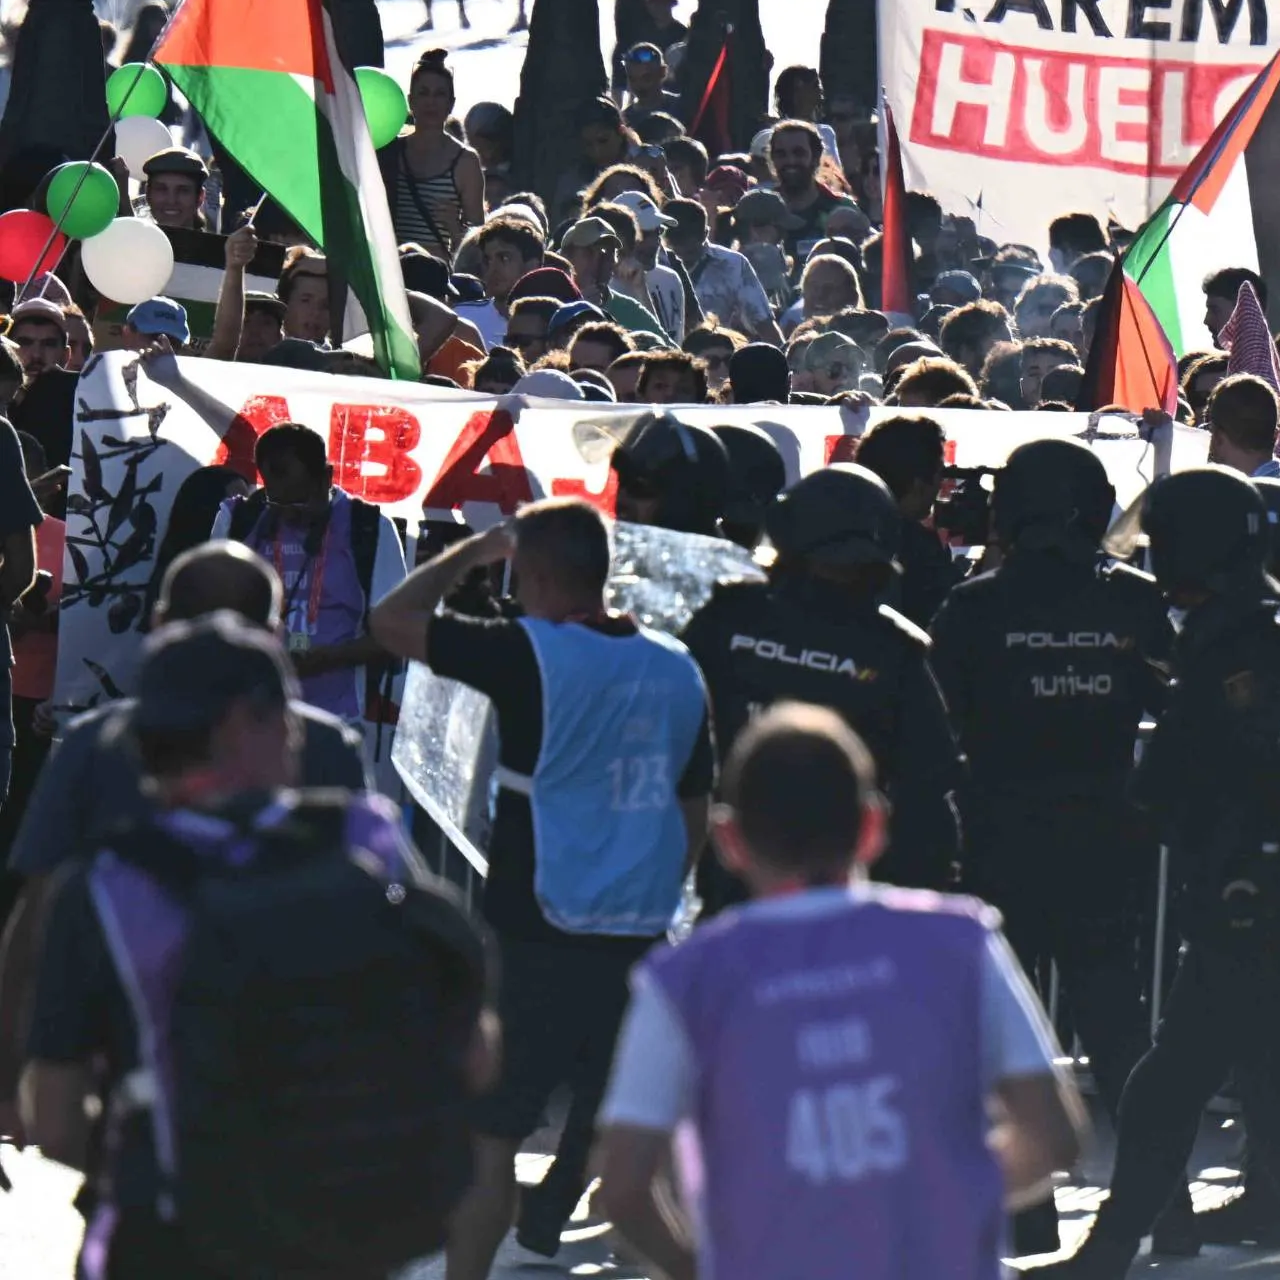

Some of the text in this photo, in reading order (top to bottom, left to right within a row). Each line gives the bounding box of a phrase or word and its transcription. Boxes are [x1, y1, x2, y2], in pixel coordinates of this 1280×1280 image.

[730, 634, 858, 675] POLICIA
[1005, 631, 1119, 649] POLICIA
[786, 1074, 908, 1185] 405
